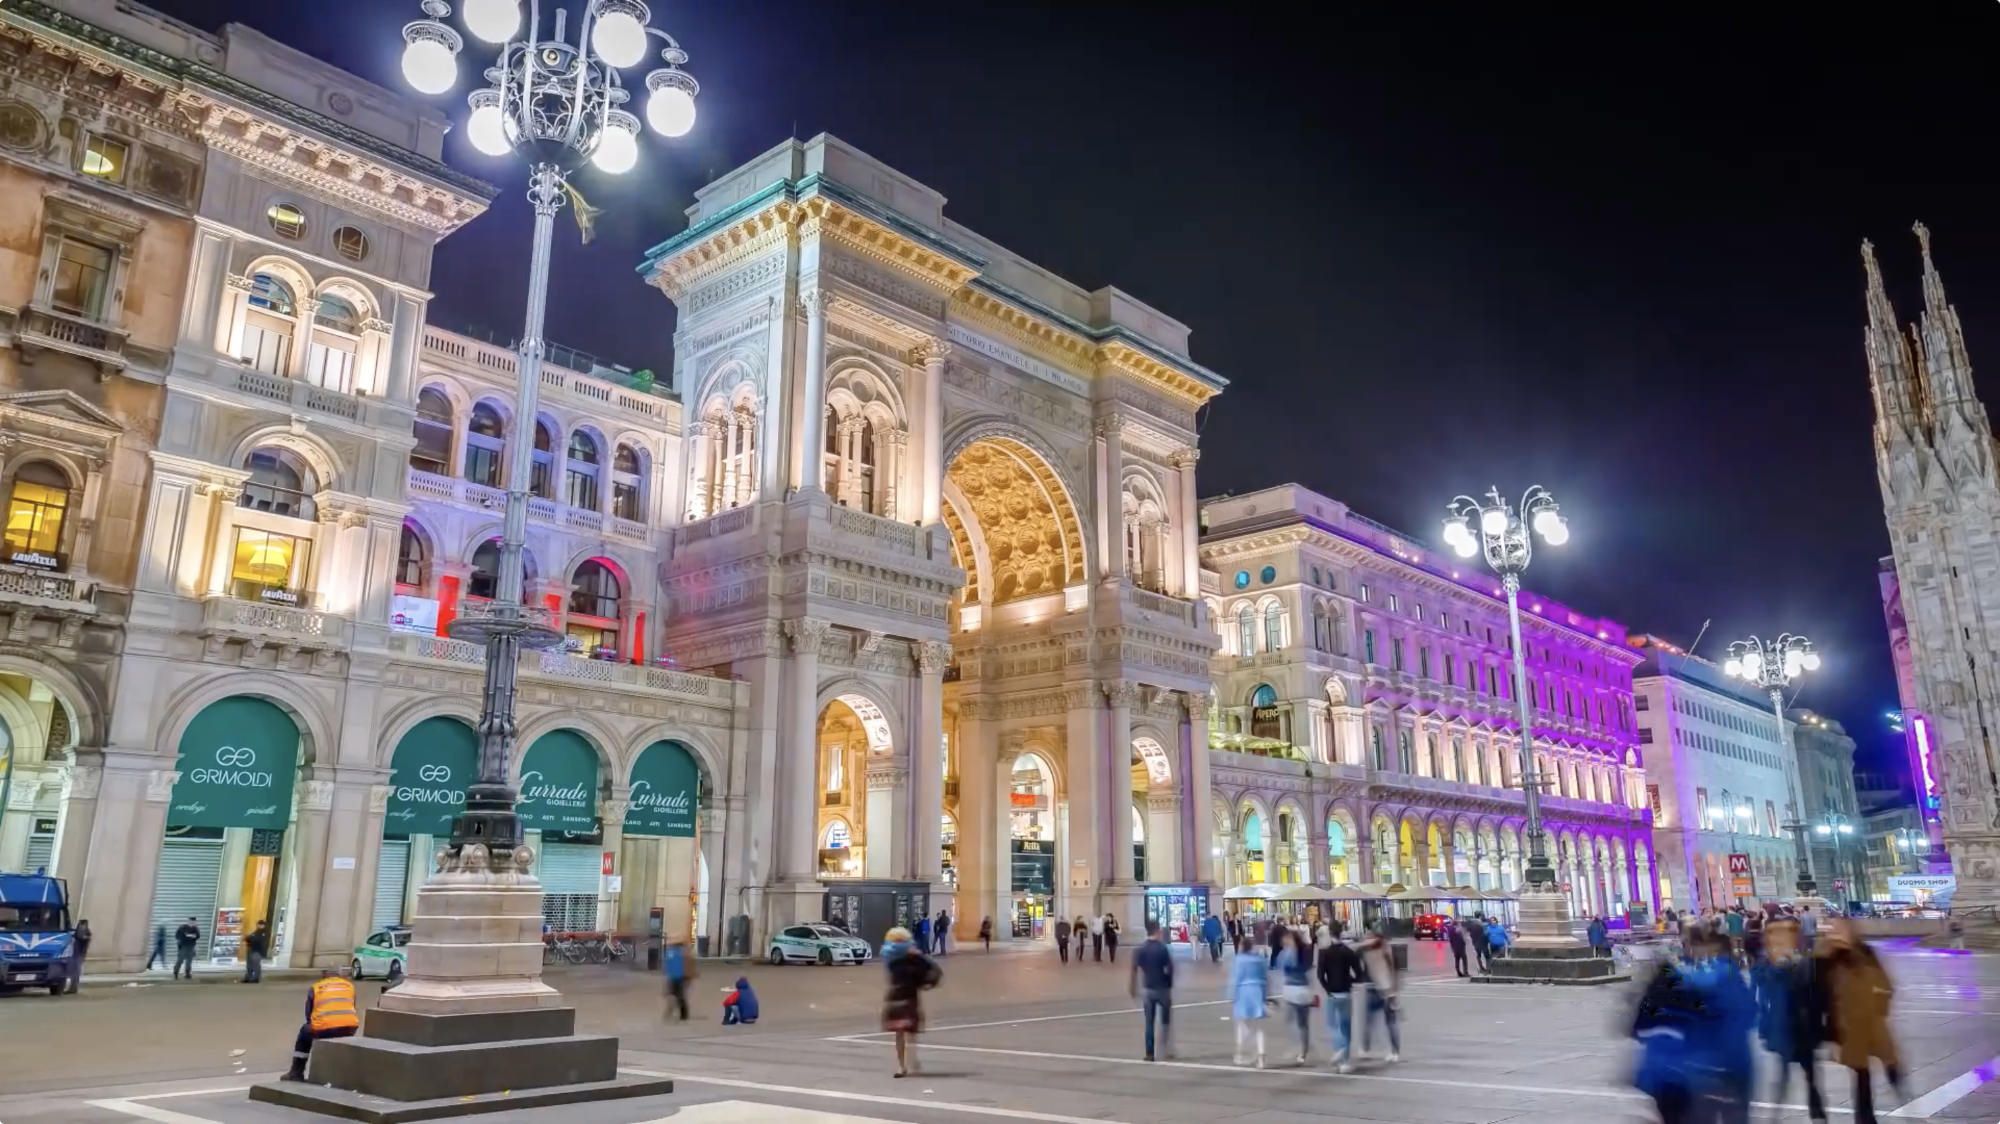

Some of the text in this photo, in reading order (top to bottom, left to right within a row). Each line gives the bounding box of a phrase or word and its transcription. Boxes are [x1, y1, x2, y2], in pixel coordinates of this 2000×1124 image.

[11, 552, 58, 567] LAVAZZA
[190, 768, 273, 788] GRIMOLDI
[397, 787, 466, 805] GRIMOLD
[1731, 857, 1748, 869] M
